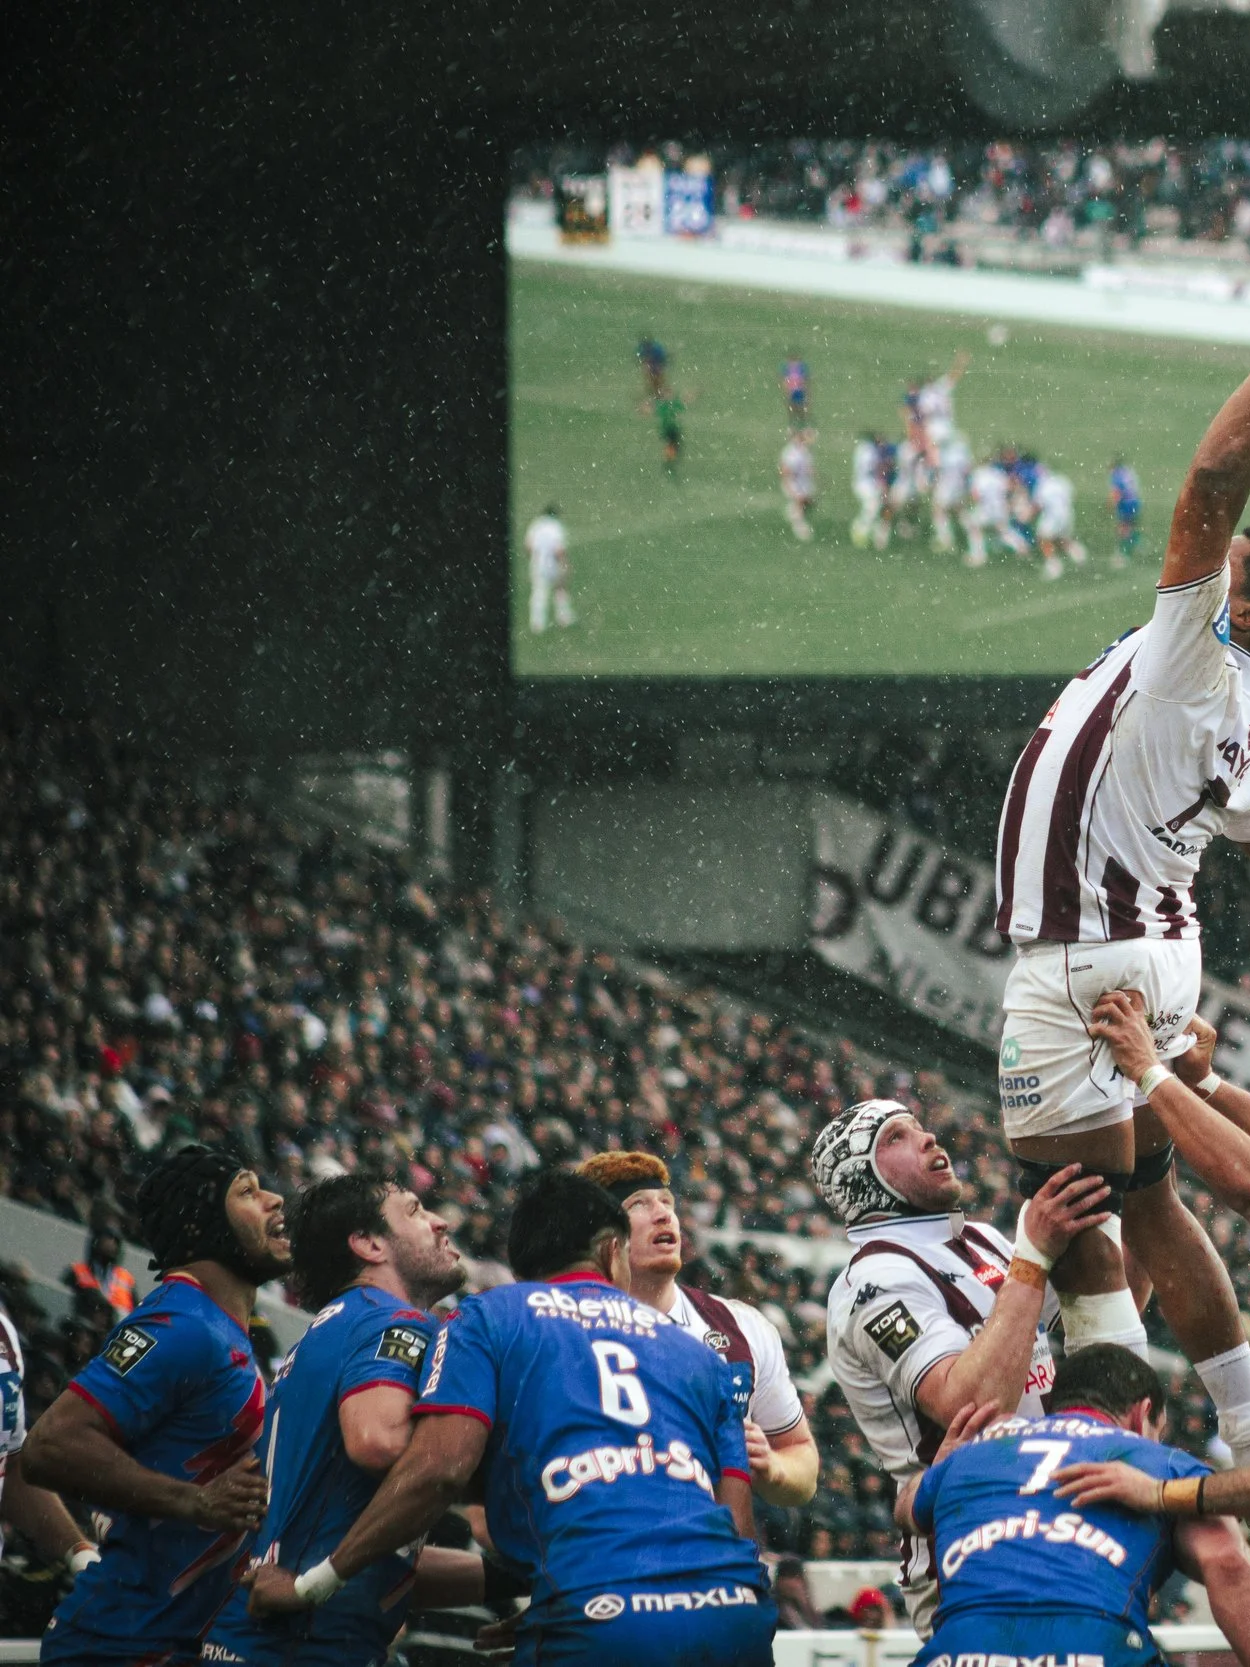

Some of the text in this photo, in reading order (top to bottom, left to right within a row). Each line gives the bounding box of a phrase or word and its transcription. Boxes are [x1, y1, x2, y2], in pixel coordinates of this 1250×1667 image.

[871, 1308, 902, 1335] TOP
[123, 1329, 148, 1349] TOP
[591, 1340, 652, 1428] 6
[733, 1392, 749, 1403] MAN
[541, 1433, 716, 1503] Capri-Su
[1018, 1439, 1072, 1495] 7
[942, 1510, 1126, 1579] Capri-Sun
[631, 1587, 758, 1612] MAXUS
[201, 1642, 246, 1662] AXU
